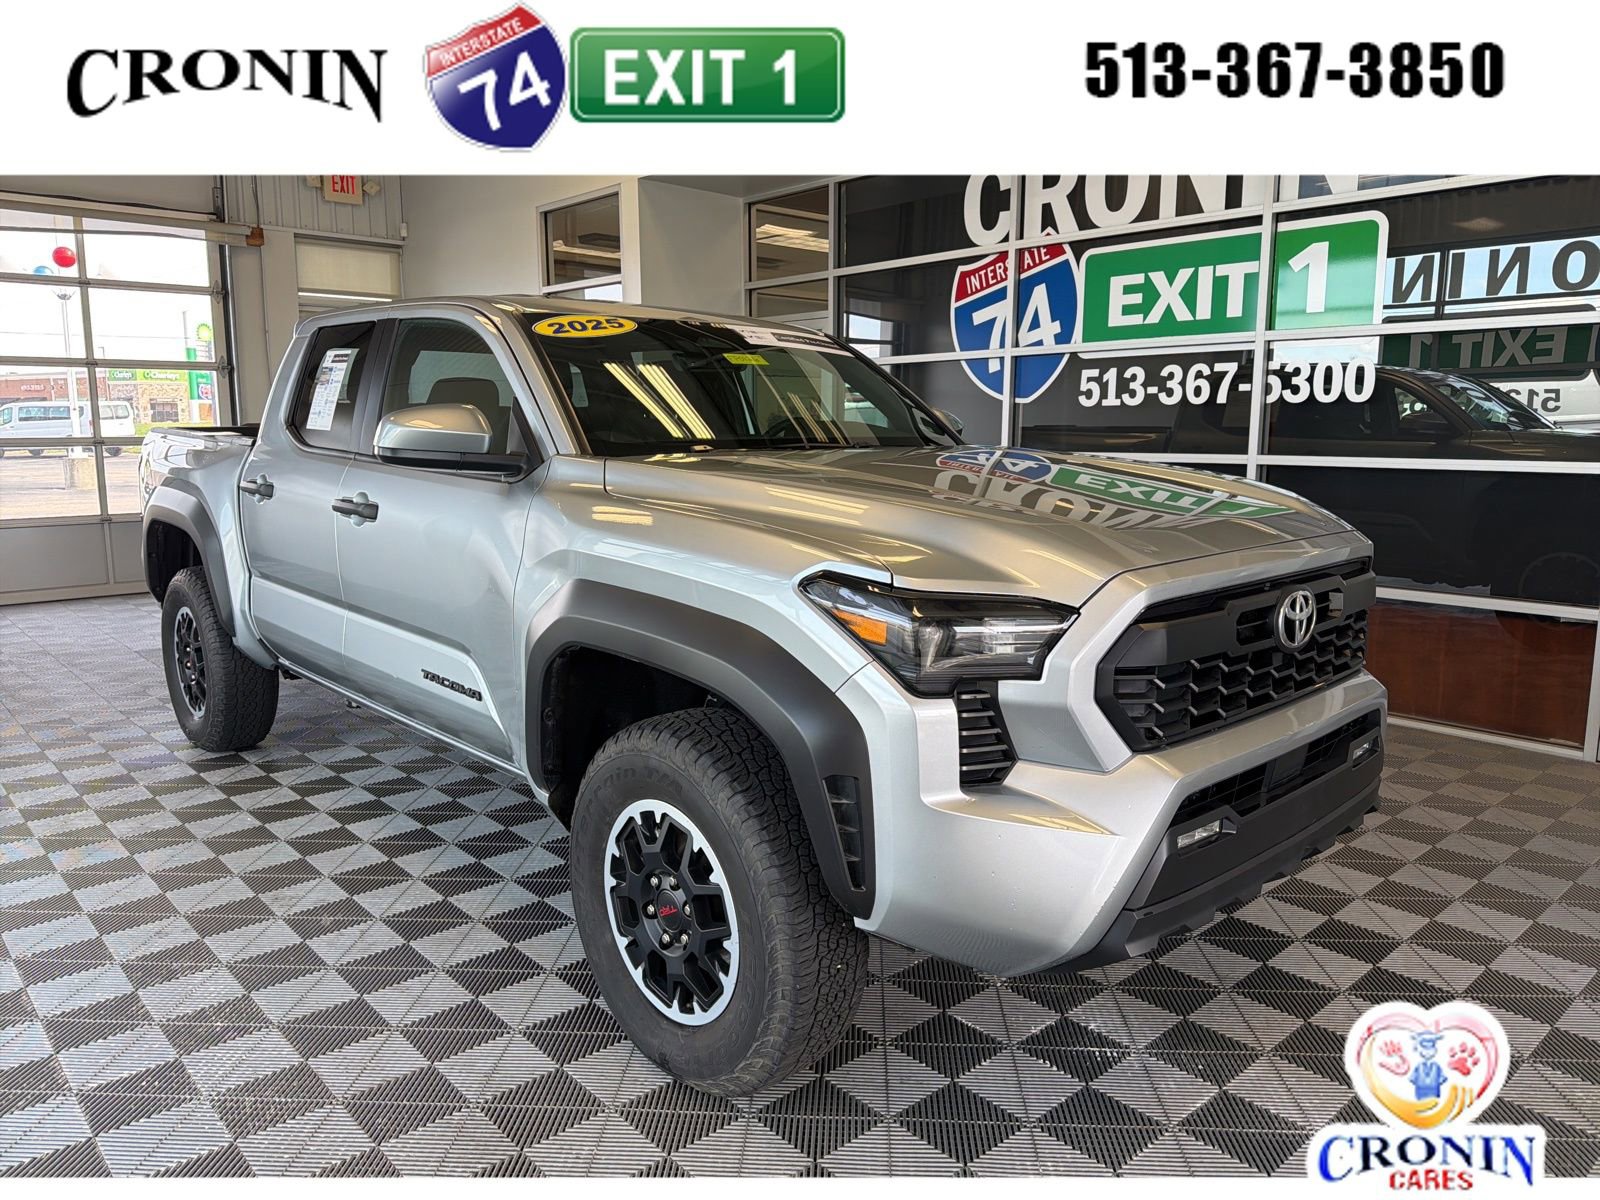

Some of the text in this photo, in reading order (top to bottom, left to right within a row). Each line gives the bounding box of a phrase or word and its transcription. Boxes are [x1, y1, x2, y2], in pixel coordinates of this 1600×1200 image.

[332, 175, 355, 195] EXIT
[966, 247, 1050, 294] INTERATE
[1108, 240, 1330, 328] EXIT 1
[547, 318, 625, 335] 2025
[971, 283, 1061, 374] 74
[421, 668, 483, 702] TACOMA
